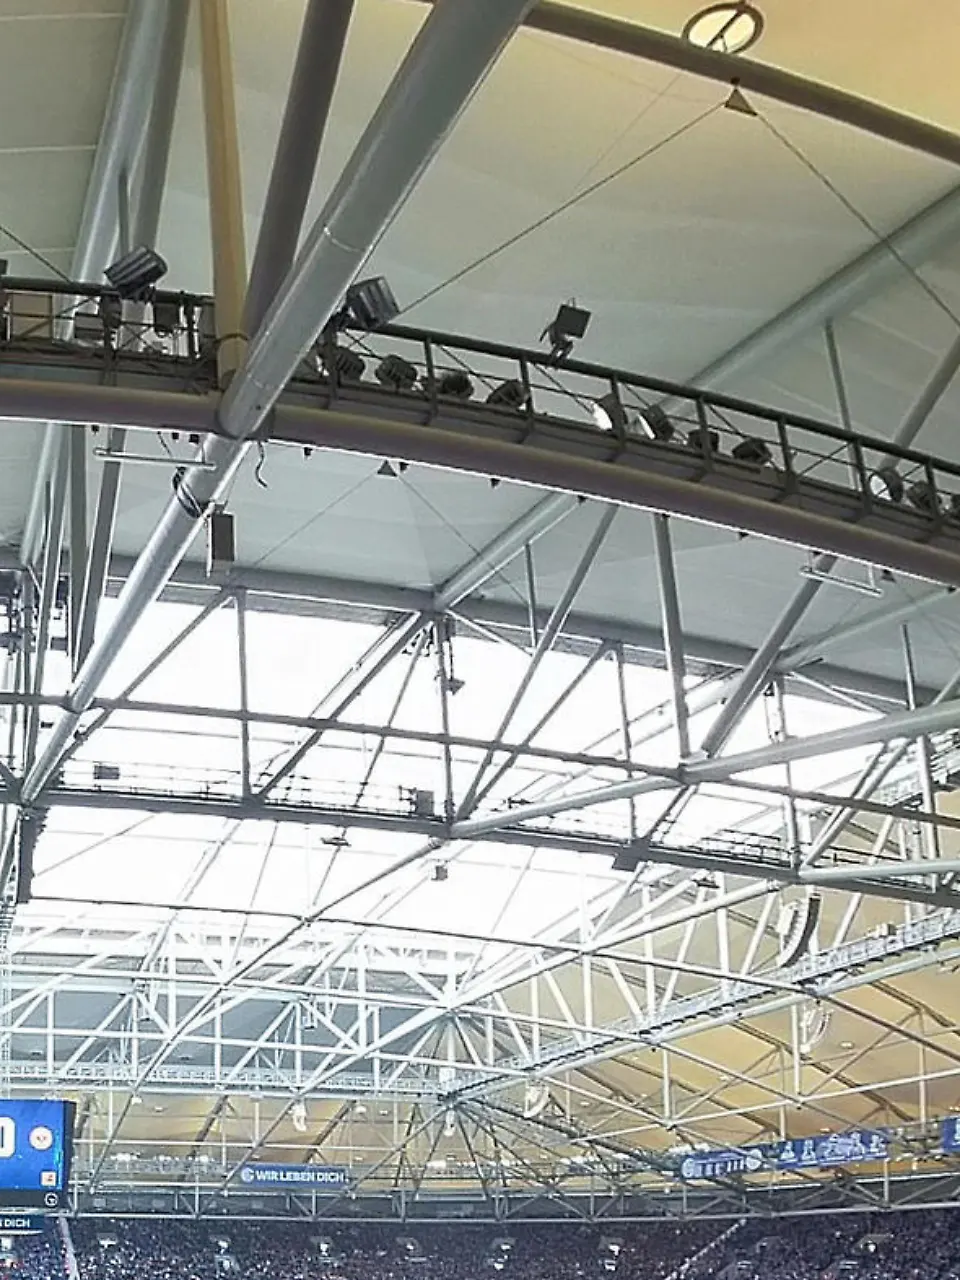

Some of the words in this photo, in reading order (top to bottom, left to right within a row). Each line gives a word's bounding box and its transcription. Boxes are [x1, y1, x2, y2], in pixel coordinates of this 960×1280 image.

[255, 1170, 279, 1181] WIR
[279, 1171, 315, 1182] LEBEN
[316, 1172, 344, 1183] DICH
[4, 1218, 30, 1229] DICH
